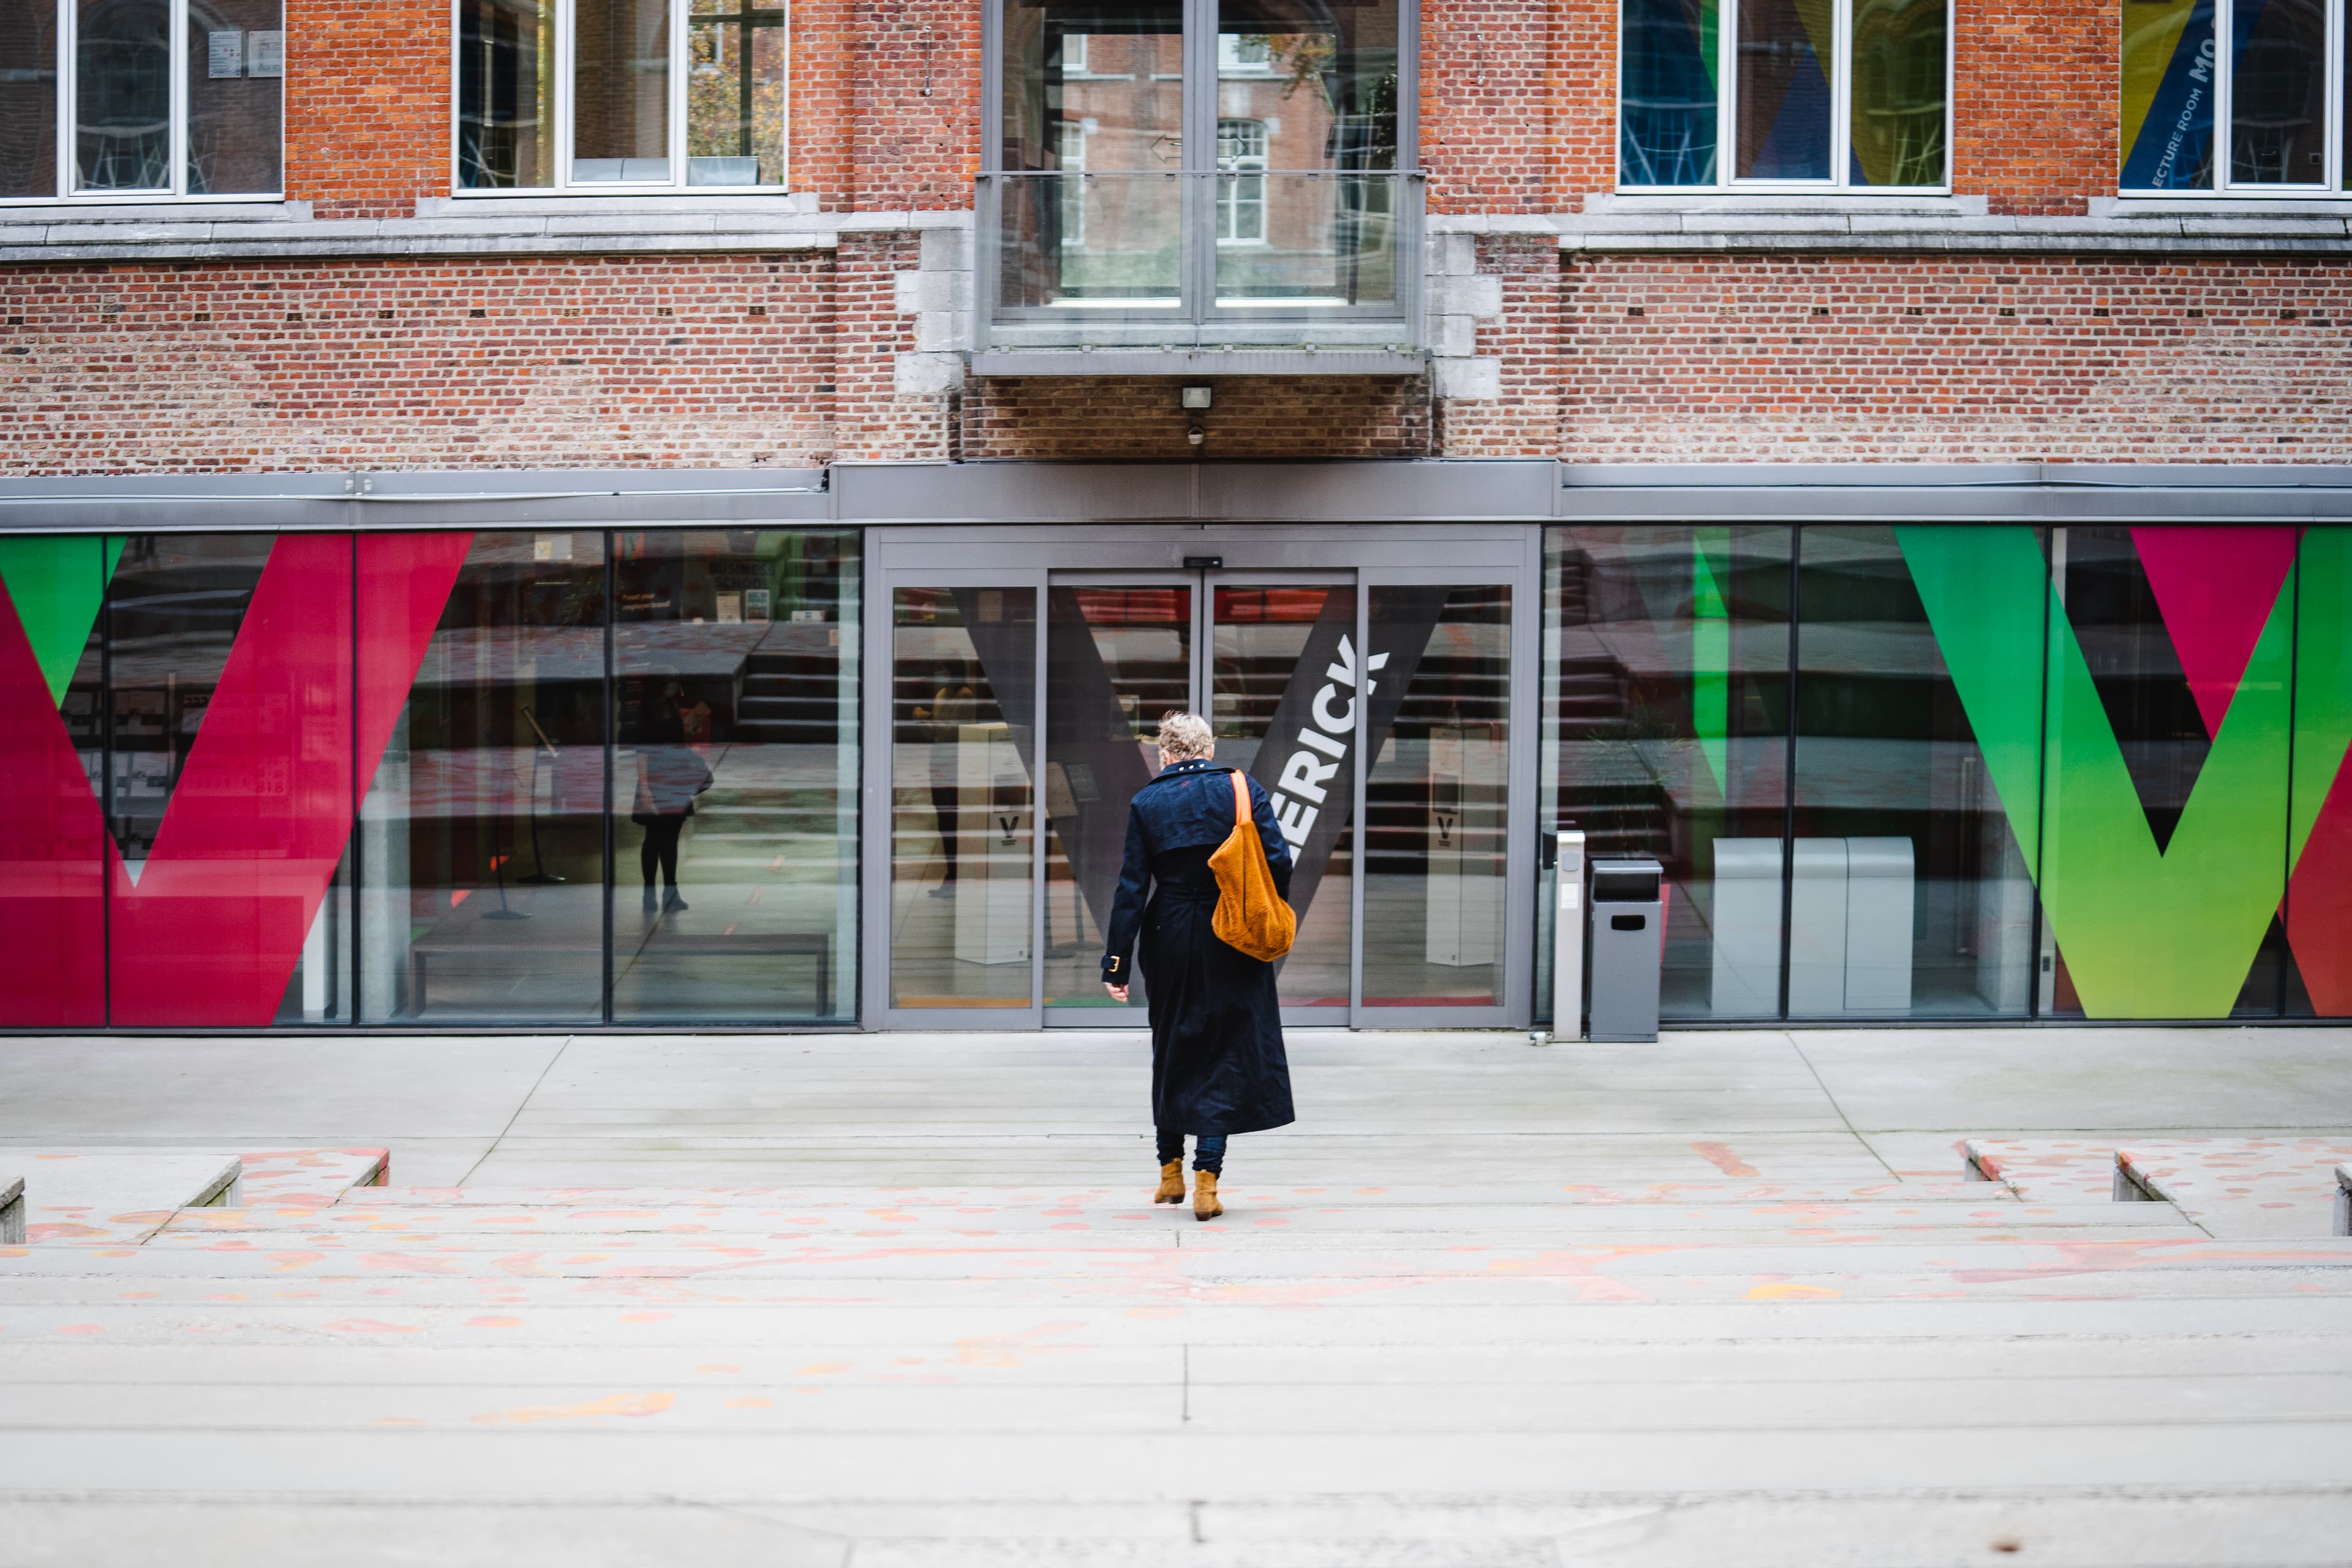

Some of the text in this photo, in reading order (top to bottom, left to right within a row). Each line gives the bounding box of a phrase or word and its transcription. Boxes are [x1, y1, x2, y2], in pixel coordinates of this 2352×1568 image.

[2152, 16, 2215, 189] ECTURE ROOM MO
